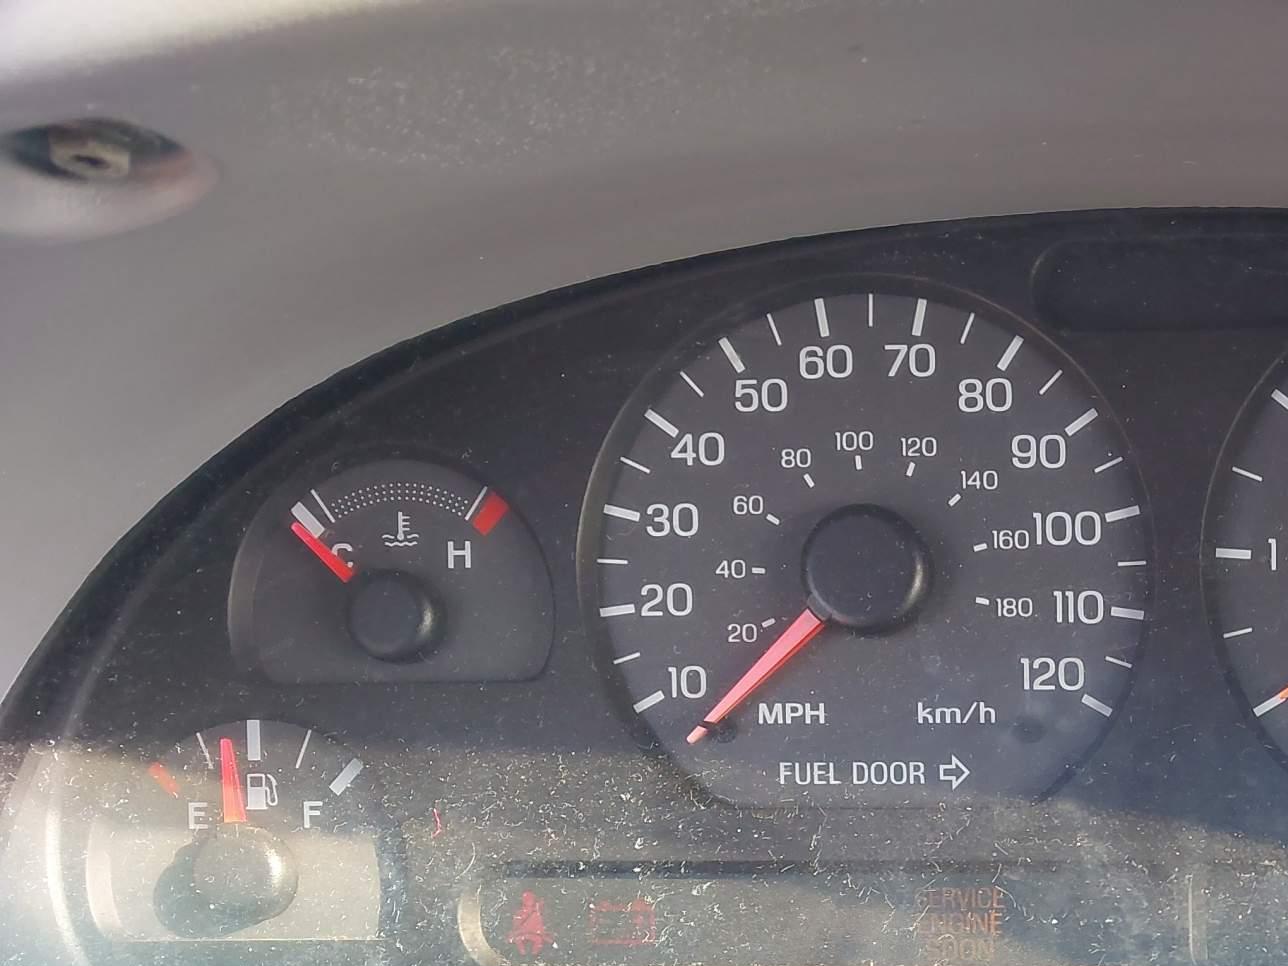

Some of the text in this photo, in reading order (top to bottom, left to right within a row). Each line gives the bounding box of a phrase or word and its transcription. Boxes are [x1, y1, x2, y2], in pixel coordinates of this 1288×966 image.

[799, 344, 853, 380] 60
[884, 343, 936, 378] 70
[735, 378, 788, 412] 50
[958, 377, 1013, 413] 80
[671, 433, 725, 466] 40
[835, 431, 874, 451] 100
[900, 437, 937, 457] 120
[1011, 435, 1066, 469] 90
[781, 448, 812, 469] 80
[960, 470, 998, 490] 140
[733, 495, 764, 515] 60
[646, 503, 699, 537] 30
[1032, 511, 1101, 546] 100
[991, 529, 1030, 550] 160
[447, 540, 472, 569] H
[715, 559, 746, 579] 40
[1267, 538, 1277, 571] 1
[640, 582, 693, 617] 20
[996, 597, 1033, 618] 180
[1053, 590, 1104, 625] 110
[727, 623, 758, 643] 20
[667, 665, 707, 699] 10
[1020, 657, 1085, 691] 120
[758, 702, 825, 725] MPH
[917, 701, 996, 724] km/h
[779, 761, 925, 785] FUEL DOOR
[188, 803, 208, 829] E
[303, 800, 324, 829] F
